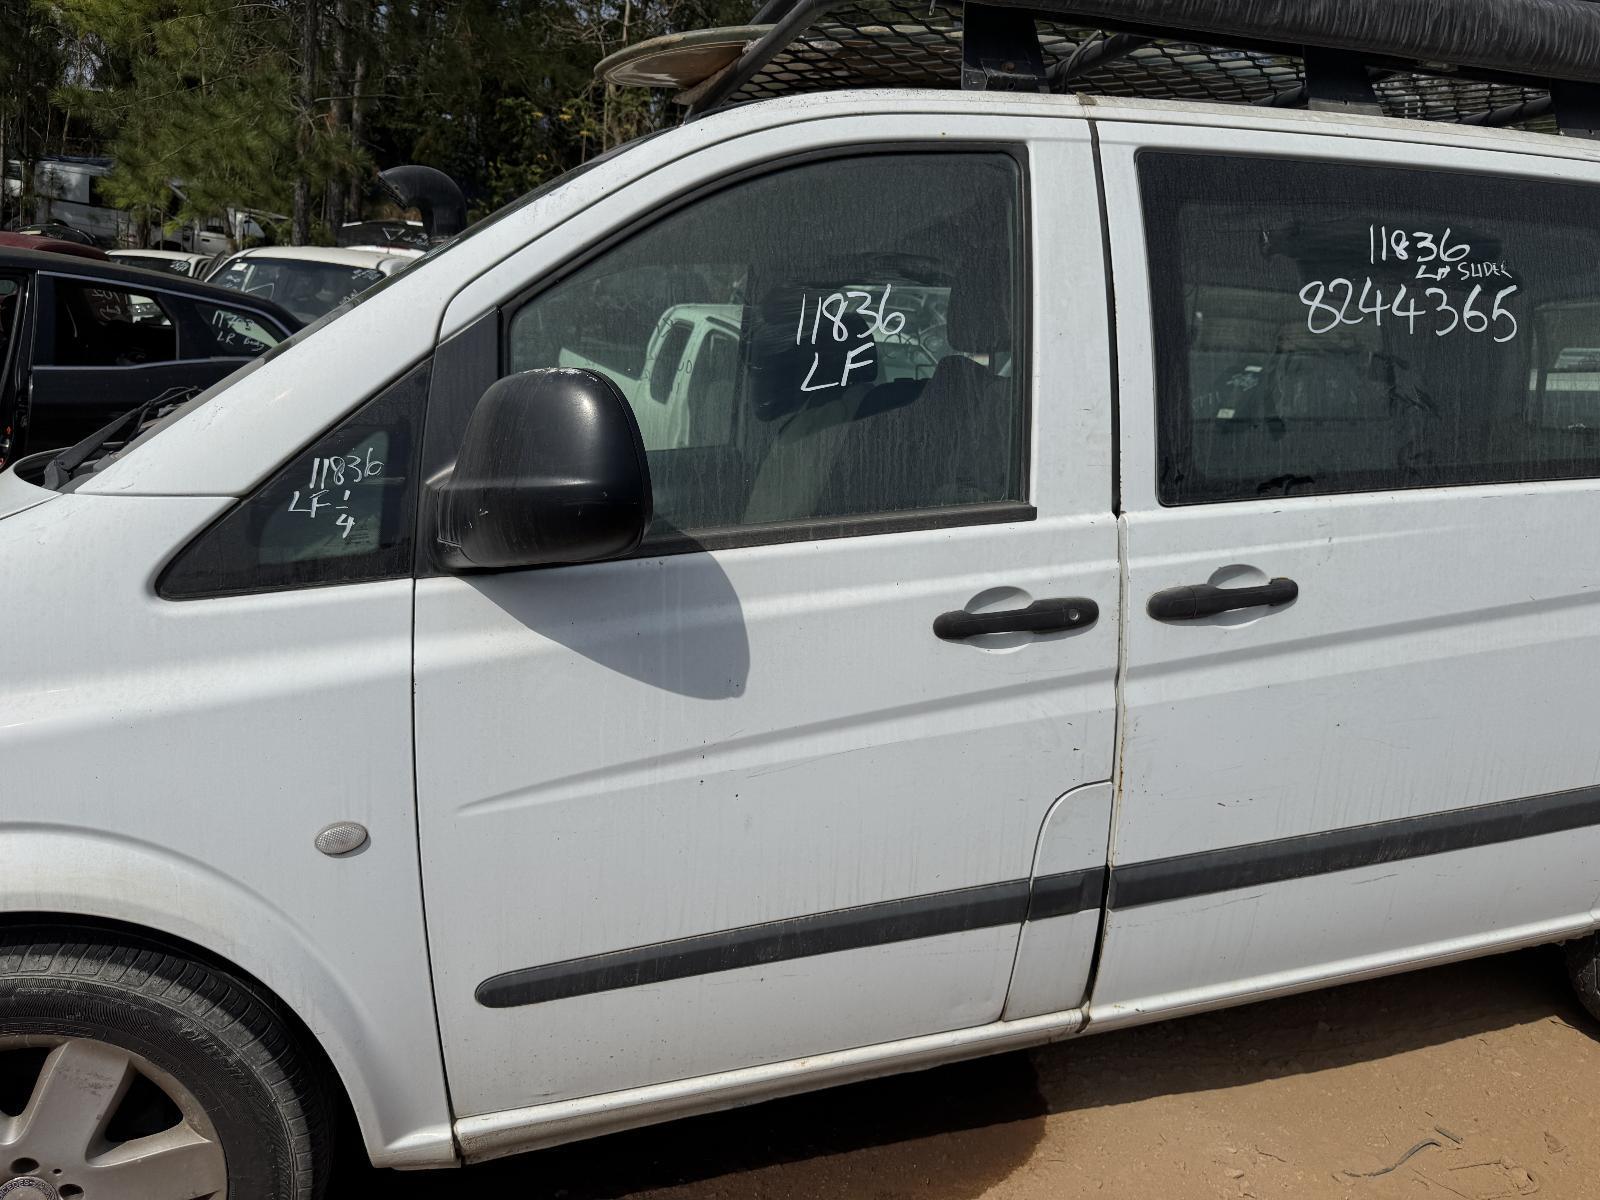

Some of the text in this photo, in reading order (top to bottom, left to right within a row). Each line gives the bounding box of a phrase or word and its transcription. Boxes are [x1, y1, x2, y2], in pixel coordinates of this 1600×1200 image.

[1369, 223, 1471, 264] 11836
[796, 283, 906, 346] 11836
[1299, 276, 1518, 343] 8244365
[800, 341, 875, 392] LF
[309, 447, 385, 490] 11836
[287, 489, 332, 519] LF
